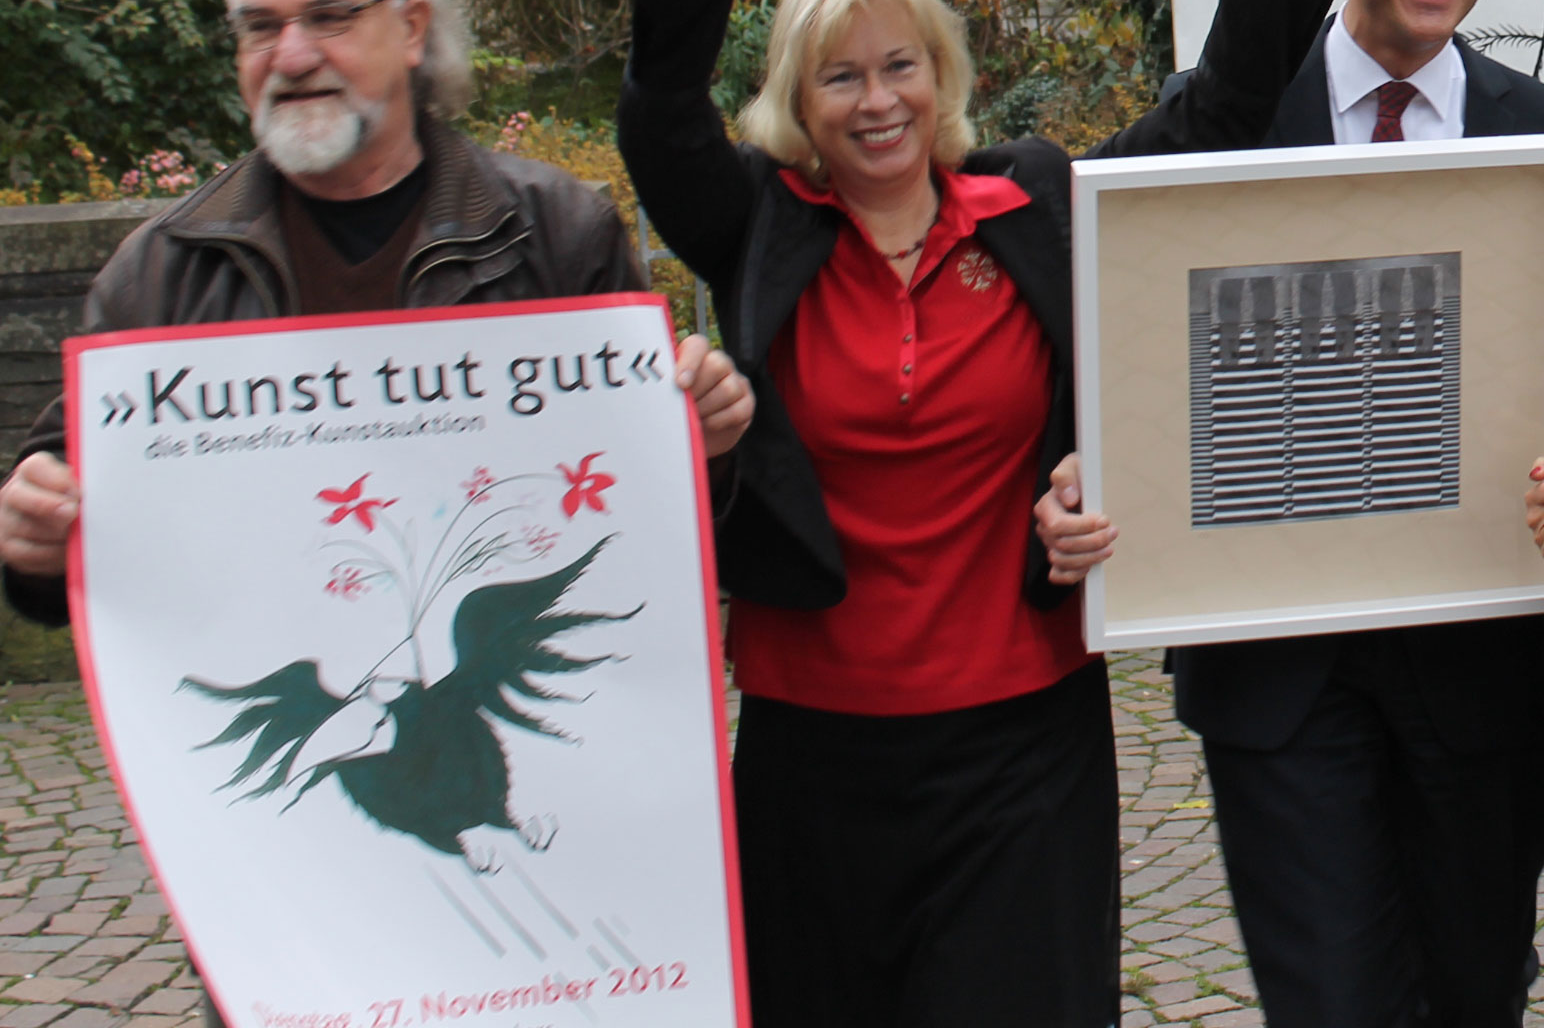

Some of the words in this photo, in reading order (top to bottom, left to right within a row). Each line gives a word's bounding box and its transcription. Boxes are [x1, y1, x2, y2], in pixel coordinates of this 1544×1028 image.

[372, 350, 487, 404] tut
[145, 433, 188, 460] die
[419, 974, 596, 1023] November
[607, 961, 689, 998] 2012
